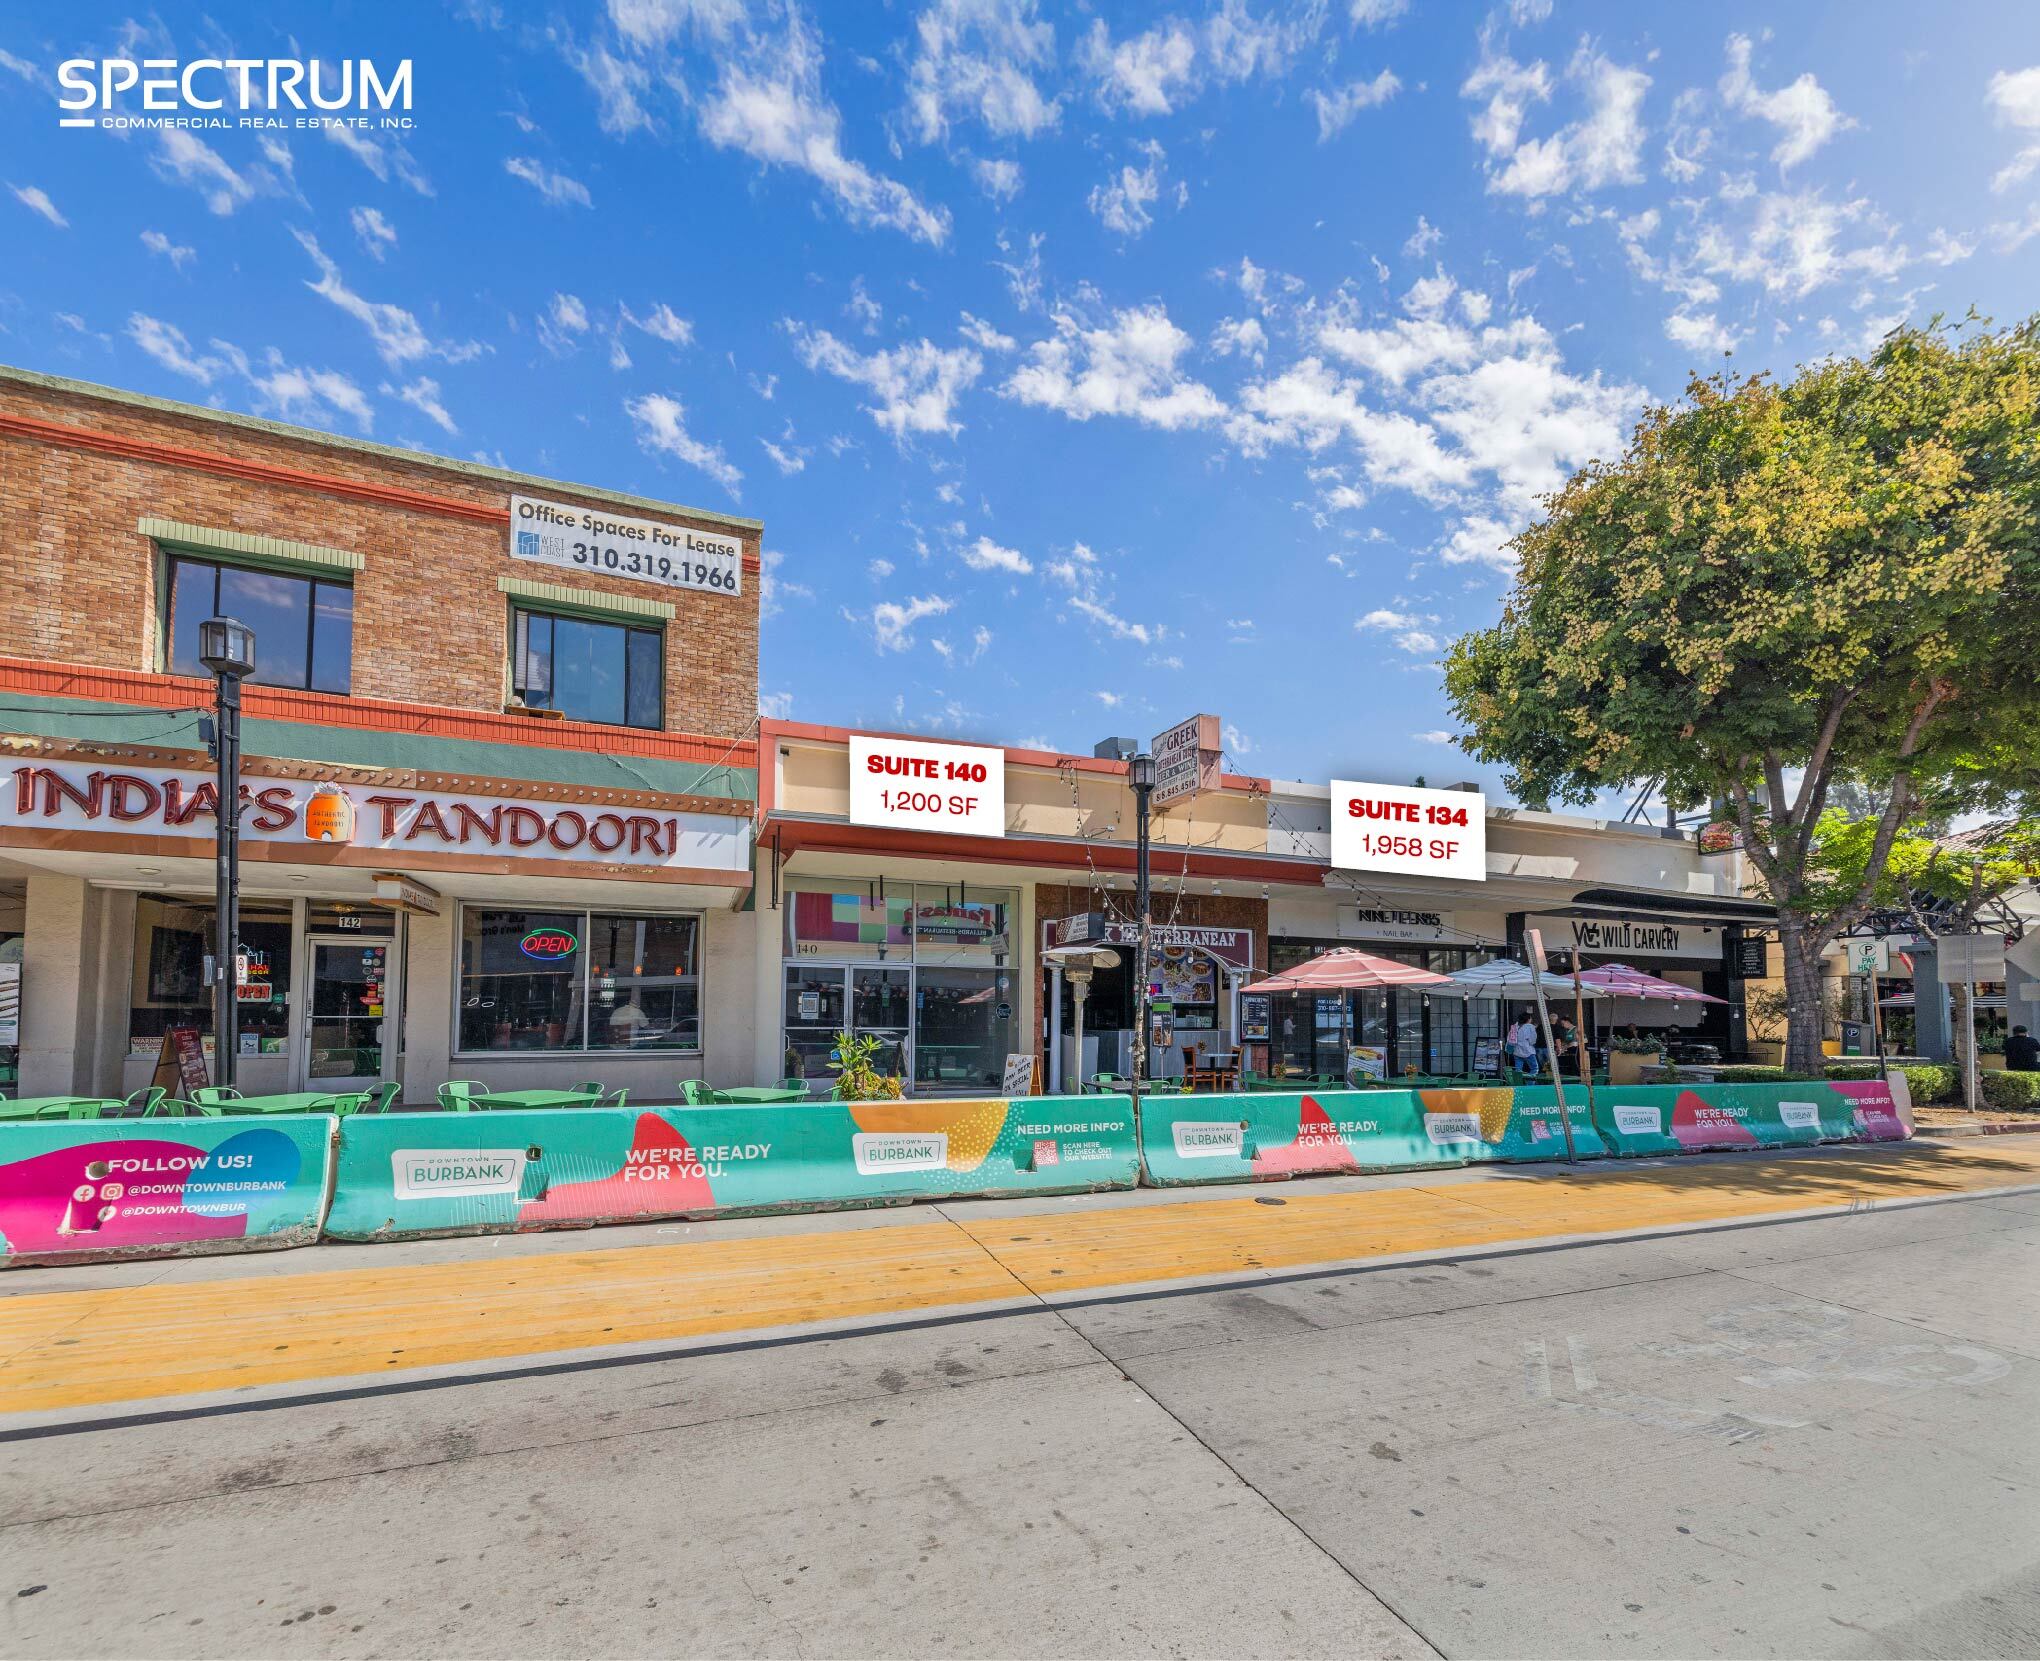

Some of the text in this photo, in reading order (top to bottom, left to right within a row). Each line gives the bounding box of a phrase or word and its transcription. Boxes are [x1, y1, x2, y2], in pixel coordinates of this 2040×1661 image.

[518, 503, 735, 557] Office Spaces For Lease
[541, 536, 565, 547] WEST
[540, 546, 565, 559] COAST
[572, 542, 736, 590] 310.319.1966
[1166, 722, 1198, 750] GREEK
[366, 795, 678, 856] TANDOORI
[340, 917, 361, 928] 142
[1382, 930, 1413, 939] NAIL BAR
[1601, 926, 1631, 948] WILD
[1634, 927, 1680, 951] CARVERY
[523, 936, 573, 952] OPEN
[797, 943, 818, 955] 140
[1861, 956, 1876, 964] PAY
[237, 984, 271, 999] OPEN
[1519, 1107, 1541, 1116] NEED
[1694, 1107, 1749, 1119] WE'RE READY
[1017, 1122, 1124, 1135] NEED MORE INFO?
[1297, 1120, 1378, 1135] WE'RE READY
[1434, 1124, 1472, 1134] BURBANK
[1696, 1120, 1714, 1128] FOR
[1062, 1142, 1082, 1150] SCAN
[1298, 1134, 1356, 1148] FOR YOU.
[624, 1143, 773, 1165] WE'RE READY
[869, 1146, 933, 1161] BURBANK
[1074, 1148, 1097, 1156] CHECK
[108, 1154, 253, 1173] FOLLOW US!
[428, 1156, 491, 1164] DOWNTOWN
[414, 1164, 505, 1183] BURBANK
[624, 1163, 728, 1182] FOR YOU.
[128, 1180, 286, 1196] @DOWNTOWNBURBANK
[121, 1202, 247, 1217] @DOWNTOWNBUR
